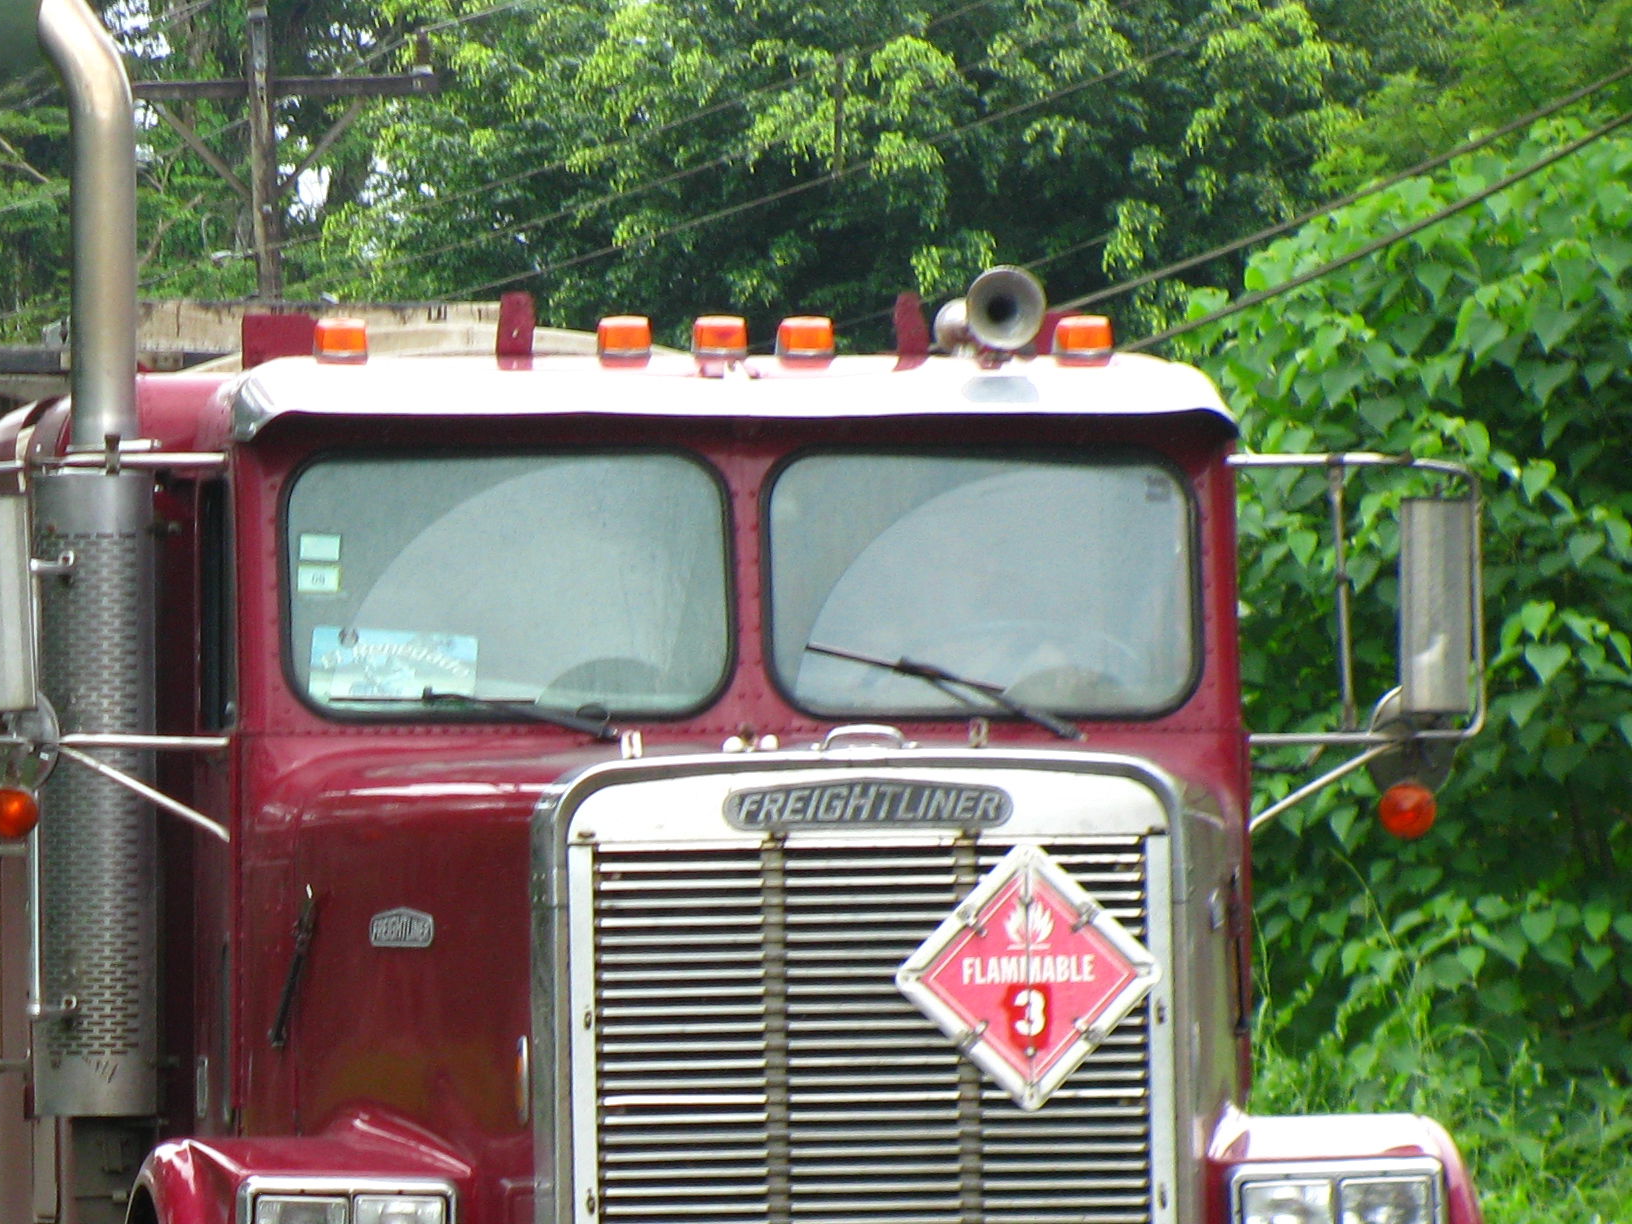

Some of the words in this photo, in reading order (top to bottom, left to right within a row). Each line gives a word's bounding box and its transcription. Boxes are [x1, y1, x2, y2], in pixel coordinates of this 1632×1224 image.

[737, 781, 1001, 823] FREIGHTLINER
[962, 954, 1096, 985] FLAMMABLE
[1014, 989, 1046, 1037] 3
